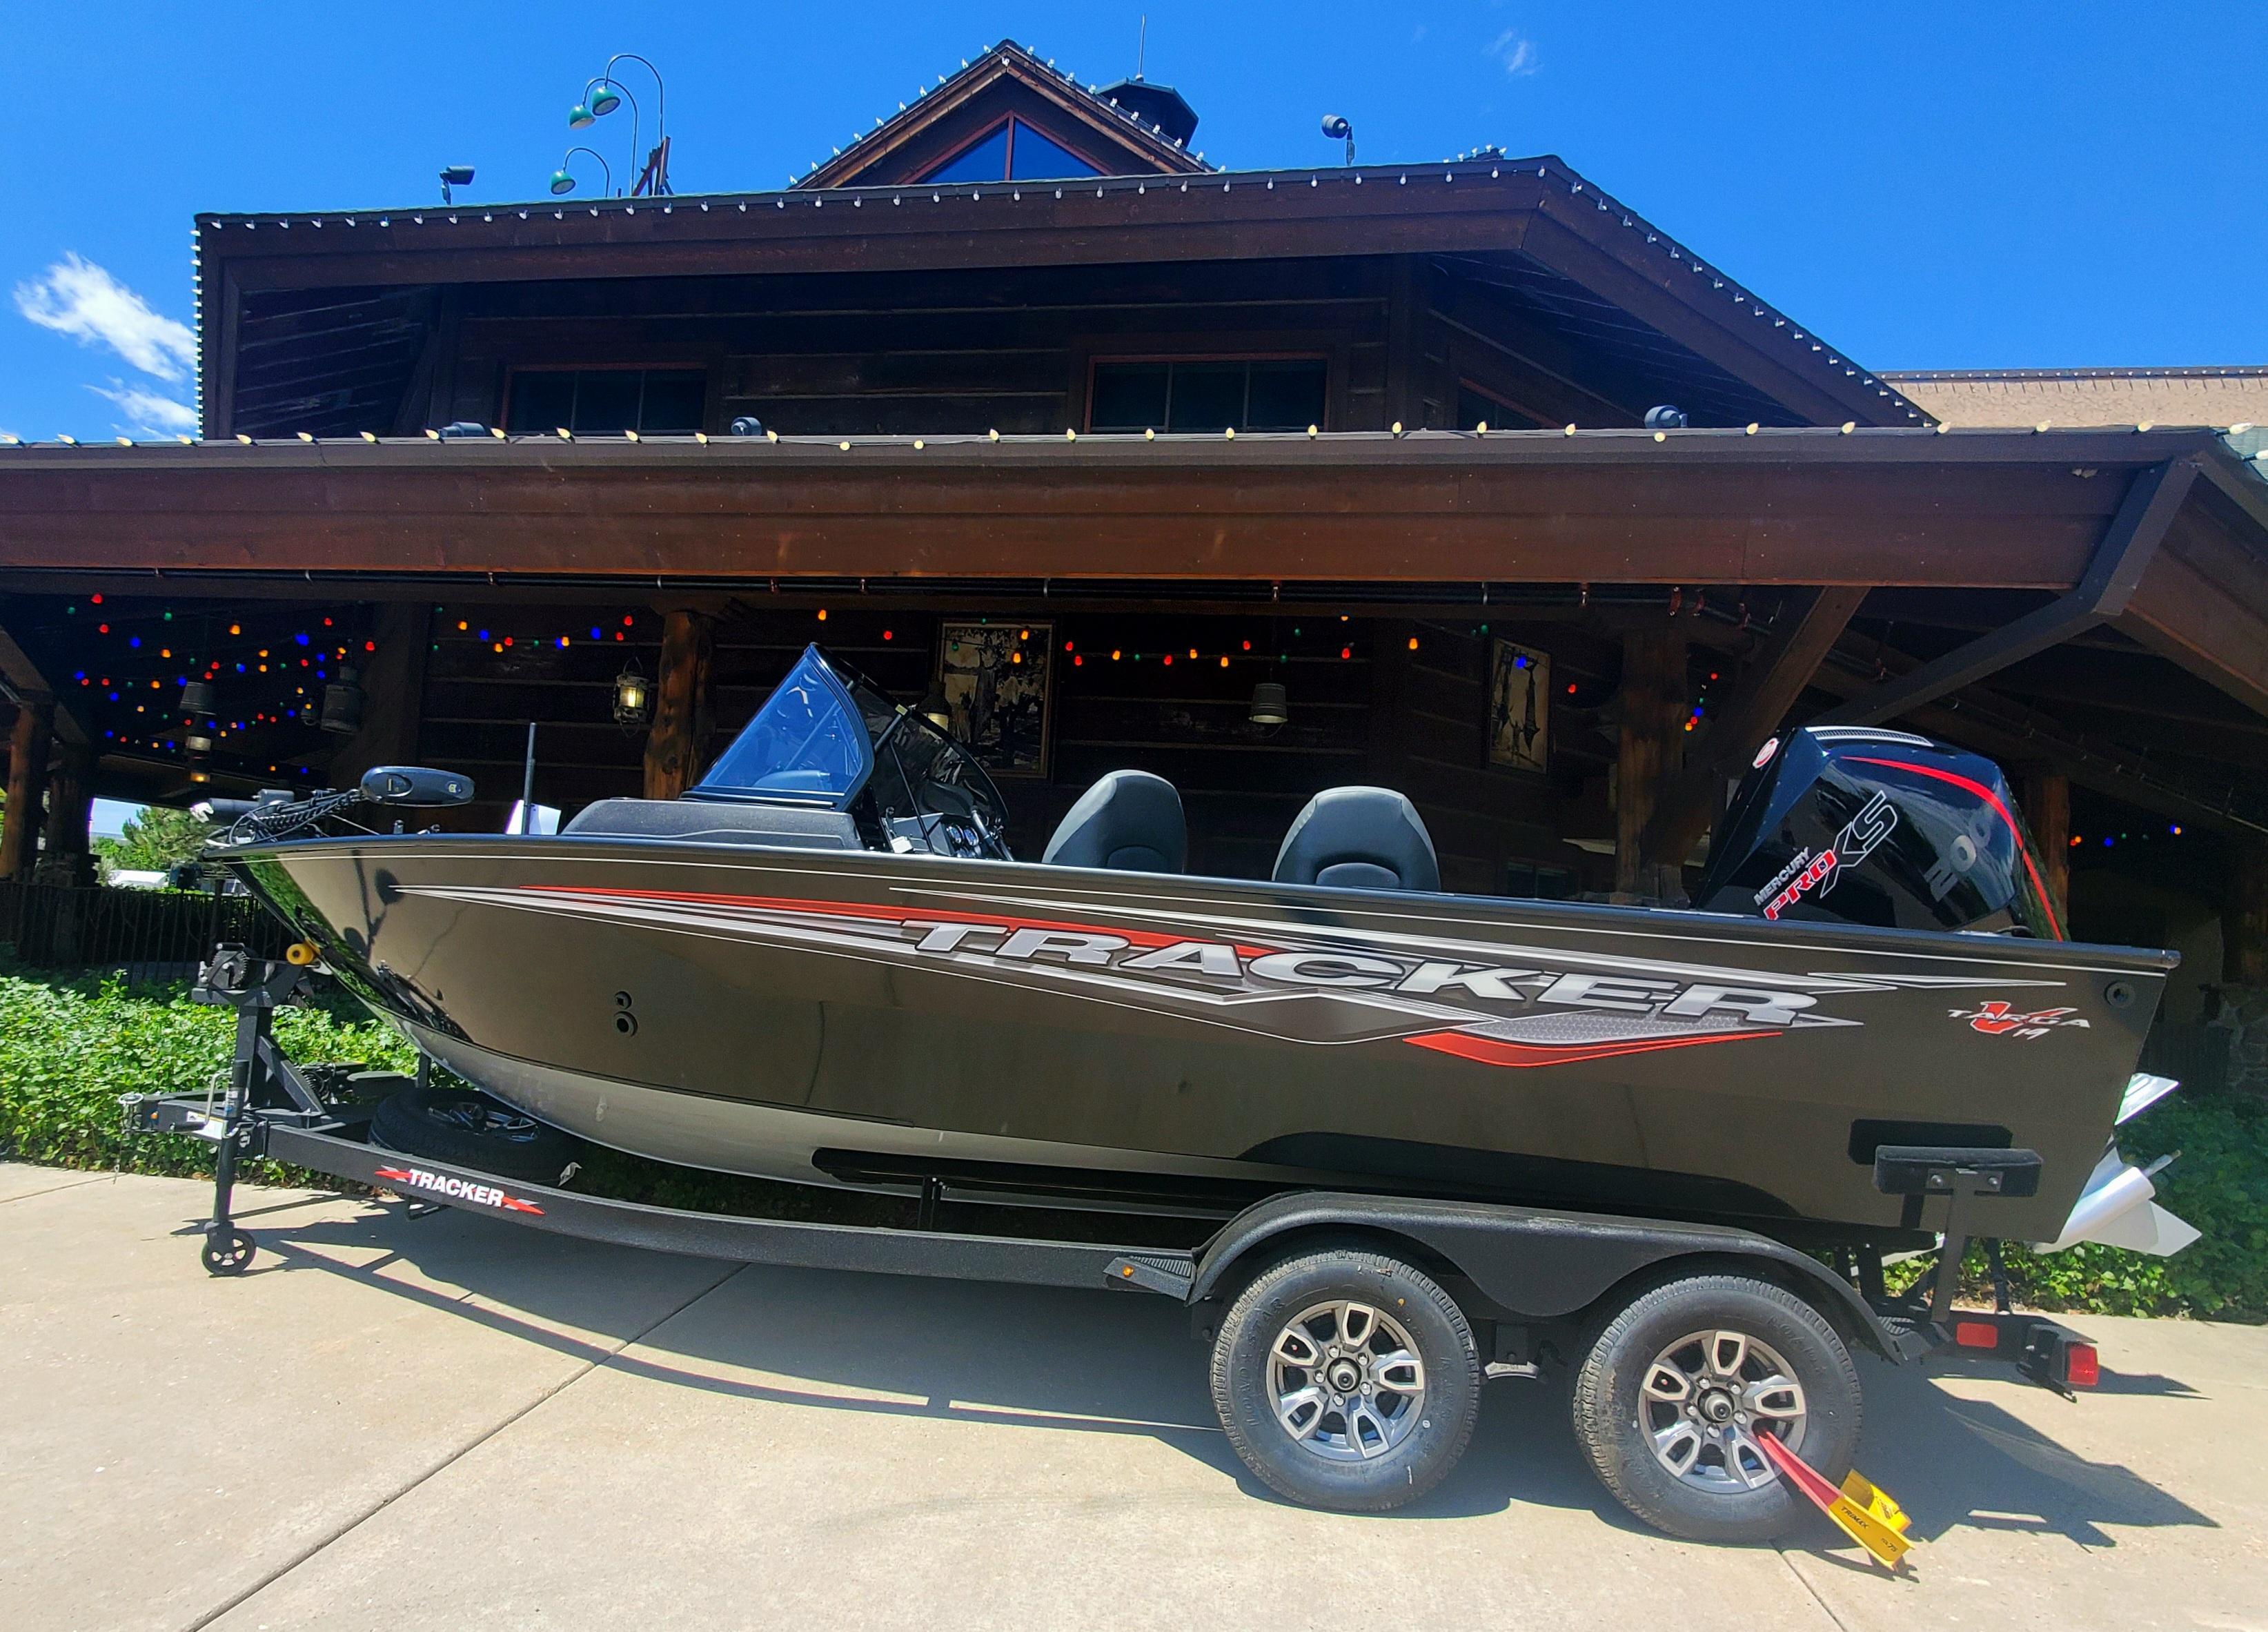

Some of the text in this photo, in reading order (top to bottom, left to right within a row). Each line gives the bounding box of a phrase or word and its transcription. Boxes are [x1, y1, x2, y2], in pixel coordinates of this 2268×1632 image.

[1753, 846, 1811, 907] MERCURY
[901, 919, 1819, 1025] TRACKER
[1947, 1009, 2091, 1028] TARGA
[2012, 1028, 2051, 1041] 19
[407, 1168, 505, 1208] TRACKER
[1840, 1505, 1869, 1529] TRIMAX
